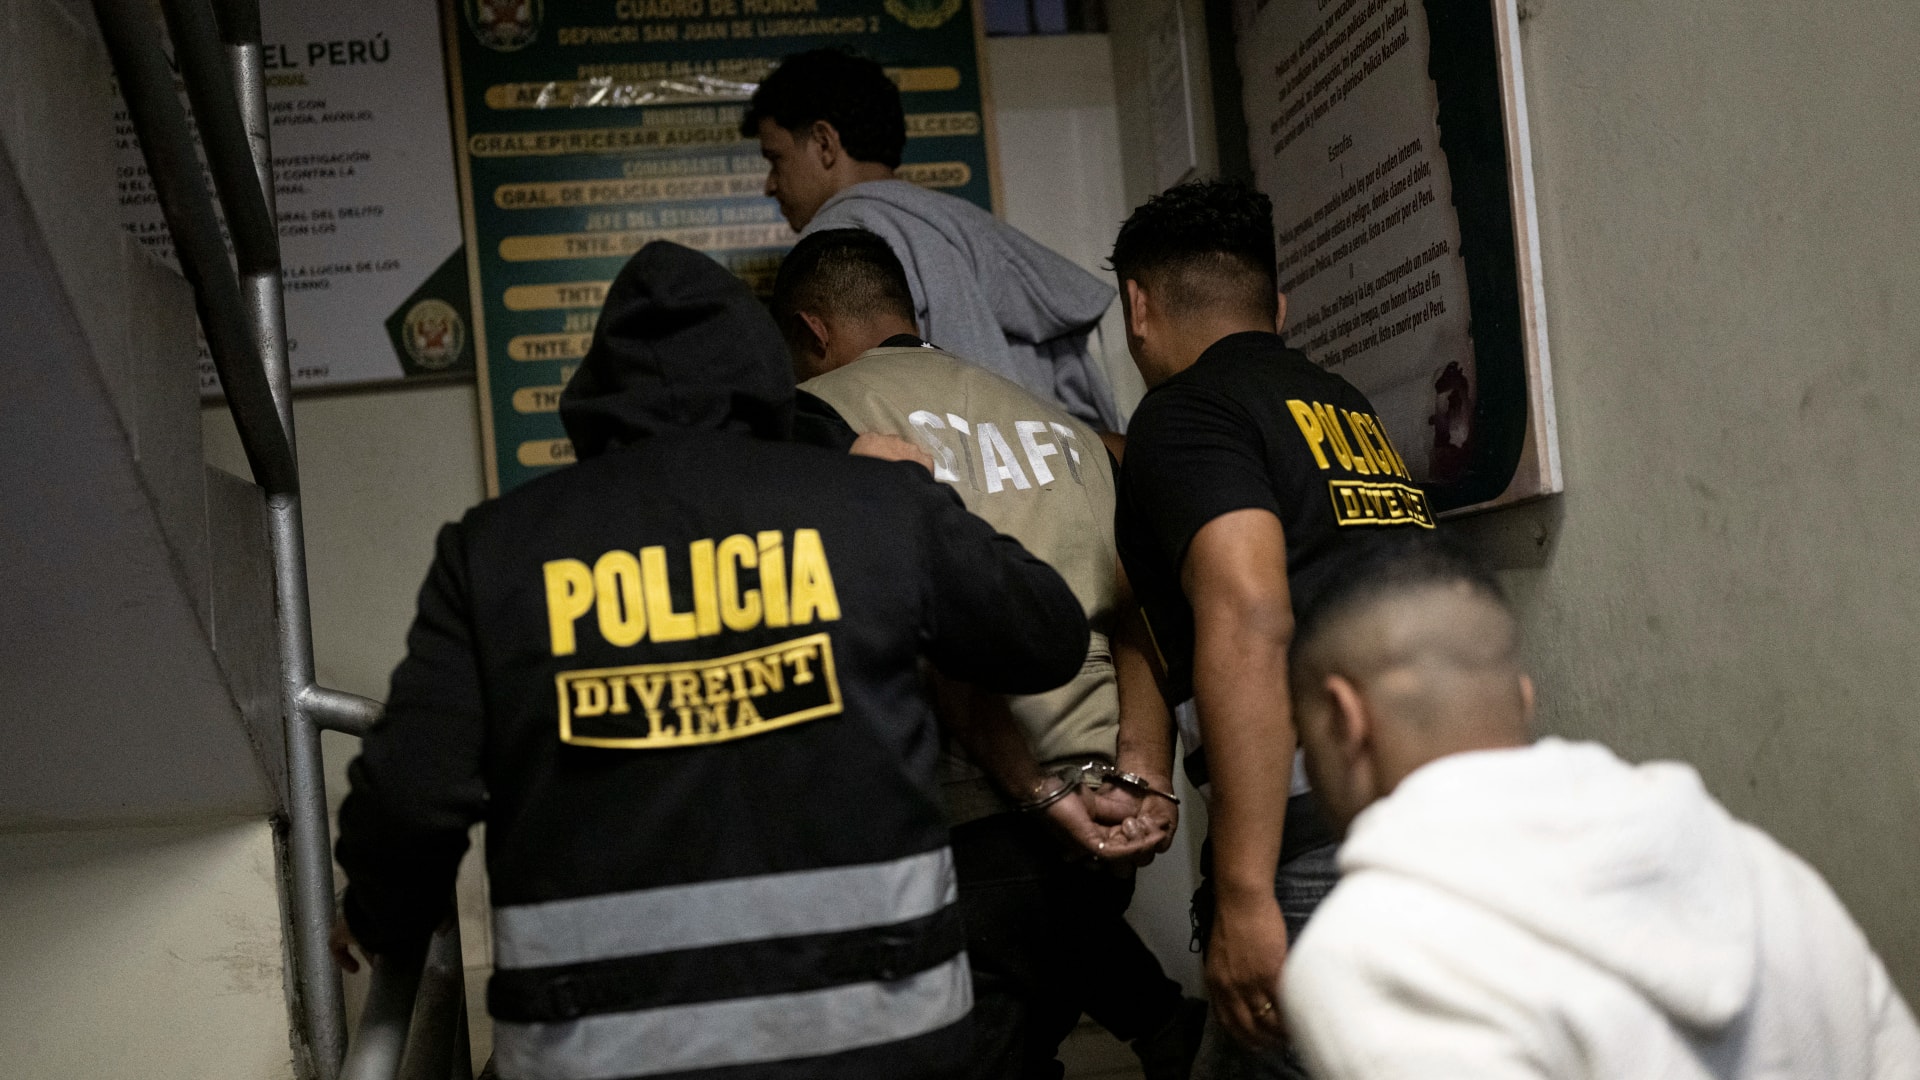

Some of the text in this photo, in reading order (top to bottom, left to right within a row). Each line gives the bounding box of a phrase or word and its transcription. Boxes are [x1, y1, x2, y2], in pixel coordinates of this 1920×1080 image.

[262, 32, 391, 69] EL PERÚ
[664, 127, 738, 145] AUGUS
[1328, 134, 1352, 162] Estrofas
[908, 410, 1083, 494] STAFF
[543, 528, 842, 656] POLICÍA
[571, 645, 818, 717] DIVREINT
[647, 698, 766, 739] LIMA
